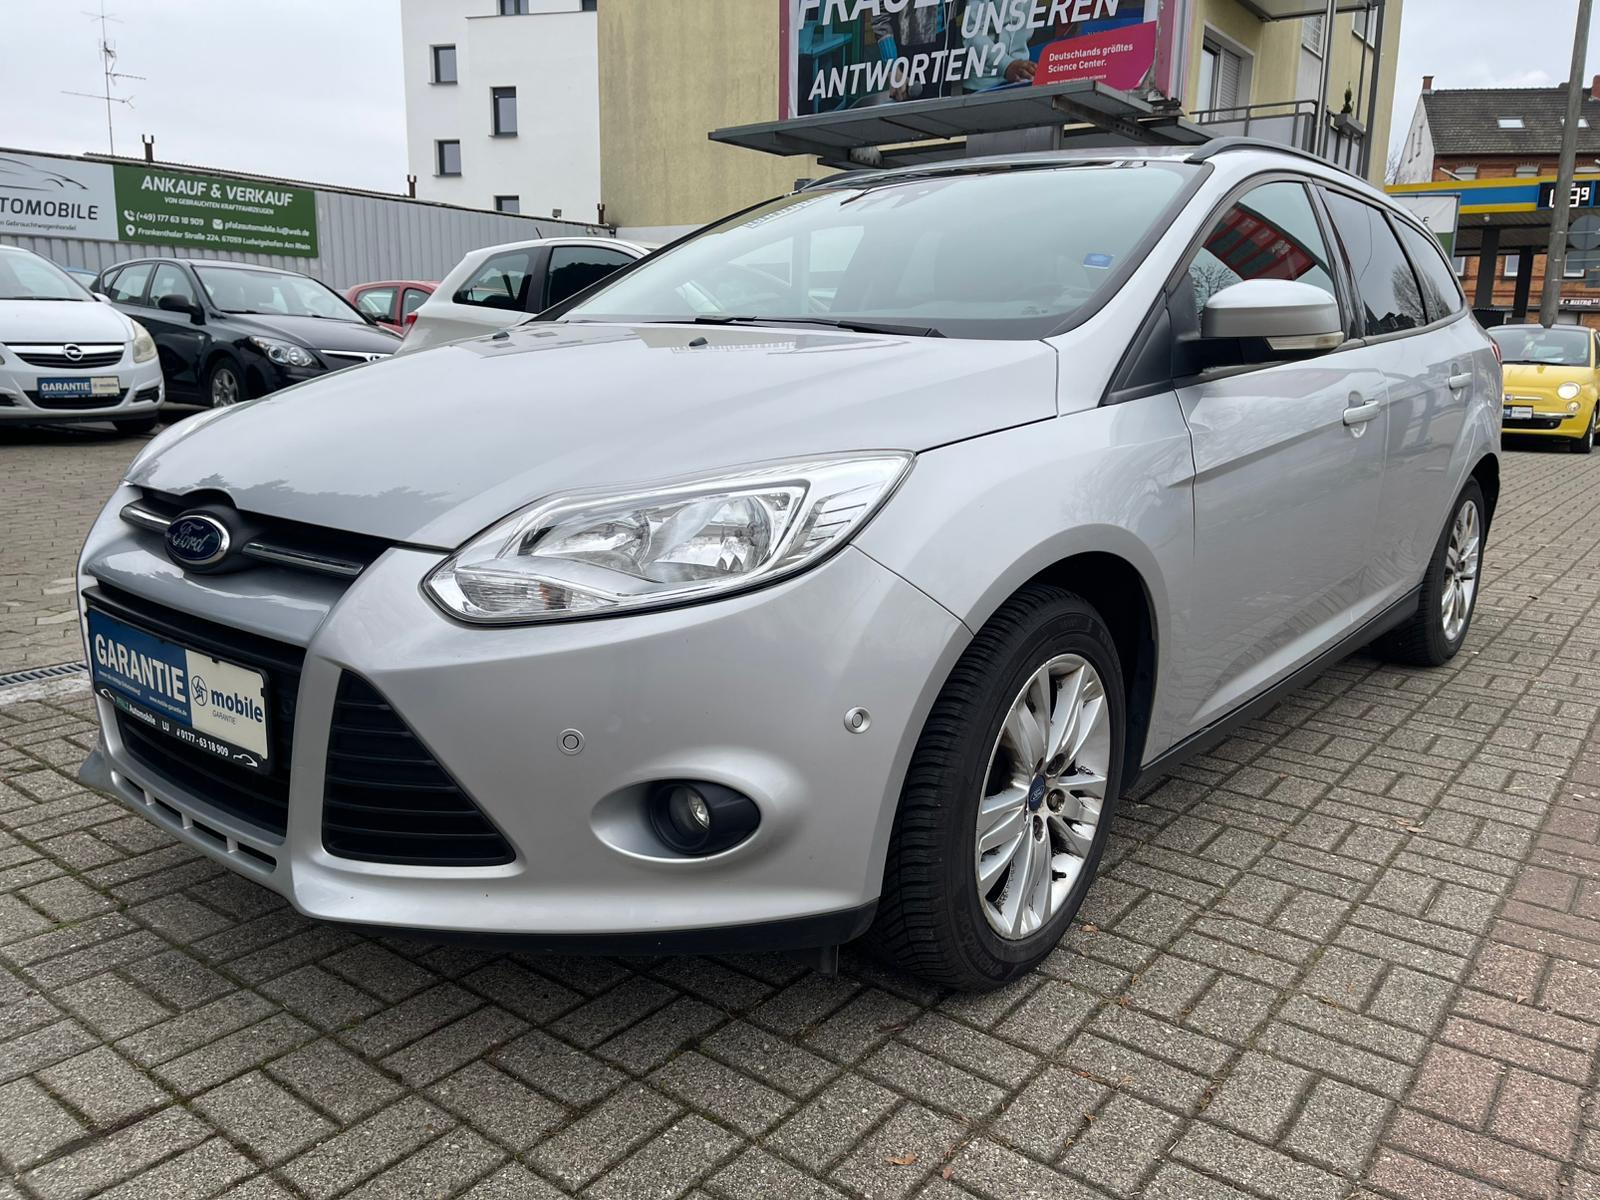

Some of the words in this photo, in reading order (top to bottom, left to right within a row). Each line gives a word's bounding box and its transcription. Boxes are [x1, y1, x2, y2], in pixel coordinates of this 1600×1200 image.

[960, 0, 1120, 39] UNSEREN
[1048, 63, 1078, 74] Science
[1079, 59, 1107, 70] Center.
[1049, 47, 1101, 62] Deutschlands
[1102, 43, 1134, 57] größtes
[808, 42, 1007, 101] ANTWORTEN?
[141, 175, 208, 196] ANKAUF
[210, 183, 222, 199] &
[226, 185, 294, 207] VERKAUF
[164, 196, 178, 205] VON
[157, 214, 170, 223] 177
[170, 215, 180, 224] 63
[181, 216, 190, 225] 18
[189, 217, 205, 227] 909
[41, 381, 91, 392] GARANTIE
[171, 519, 211, 553] Ford
[94, 632, 187, 703] GARANTIE
[210, 688, 264, 723] mobile
